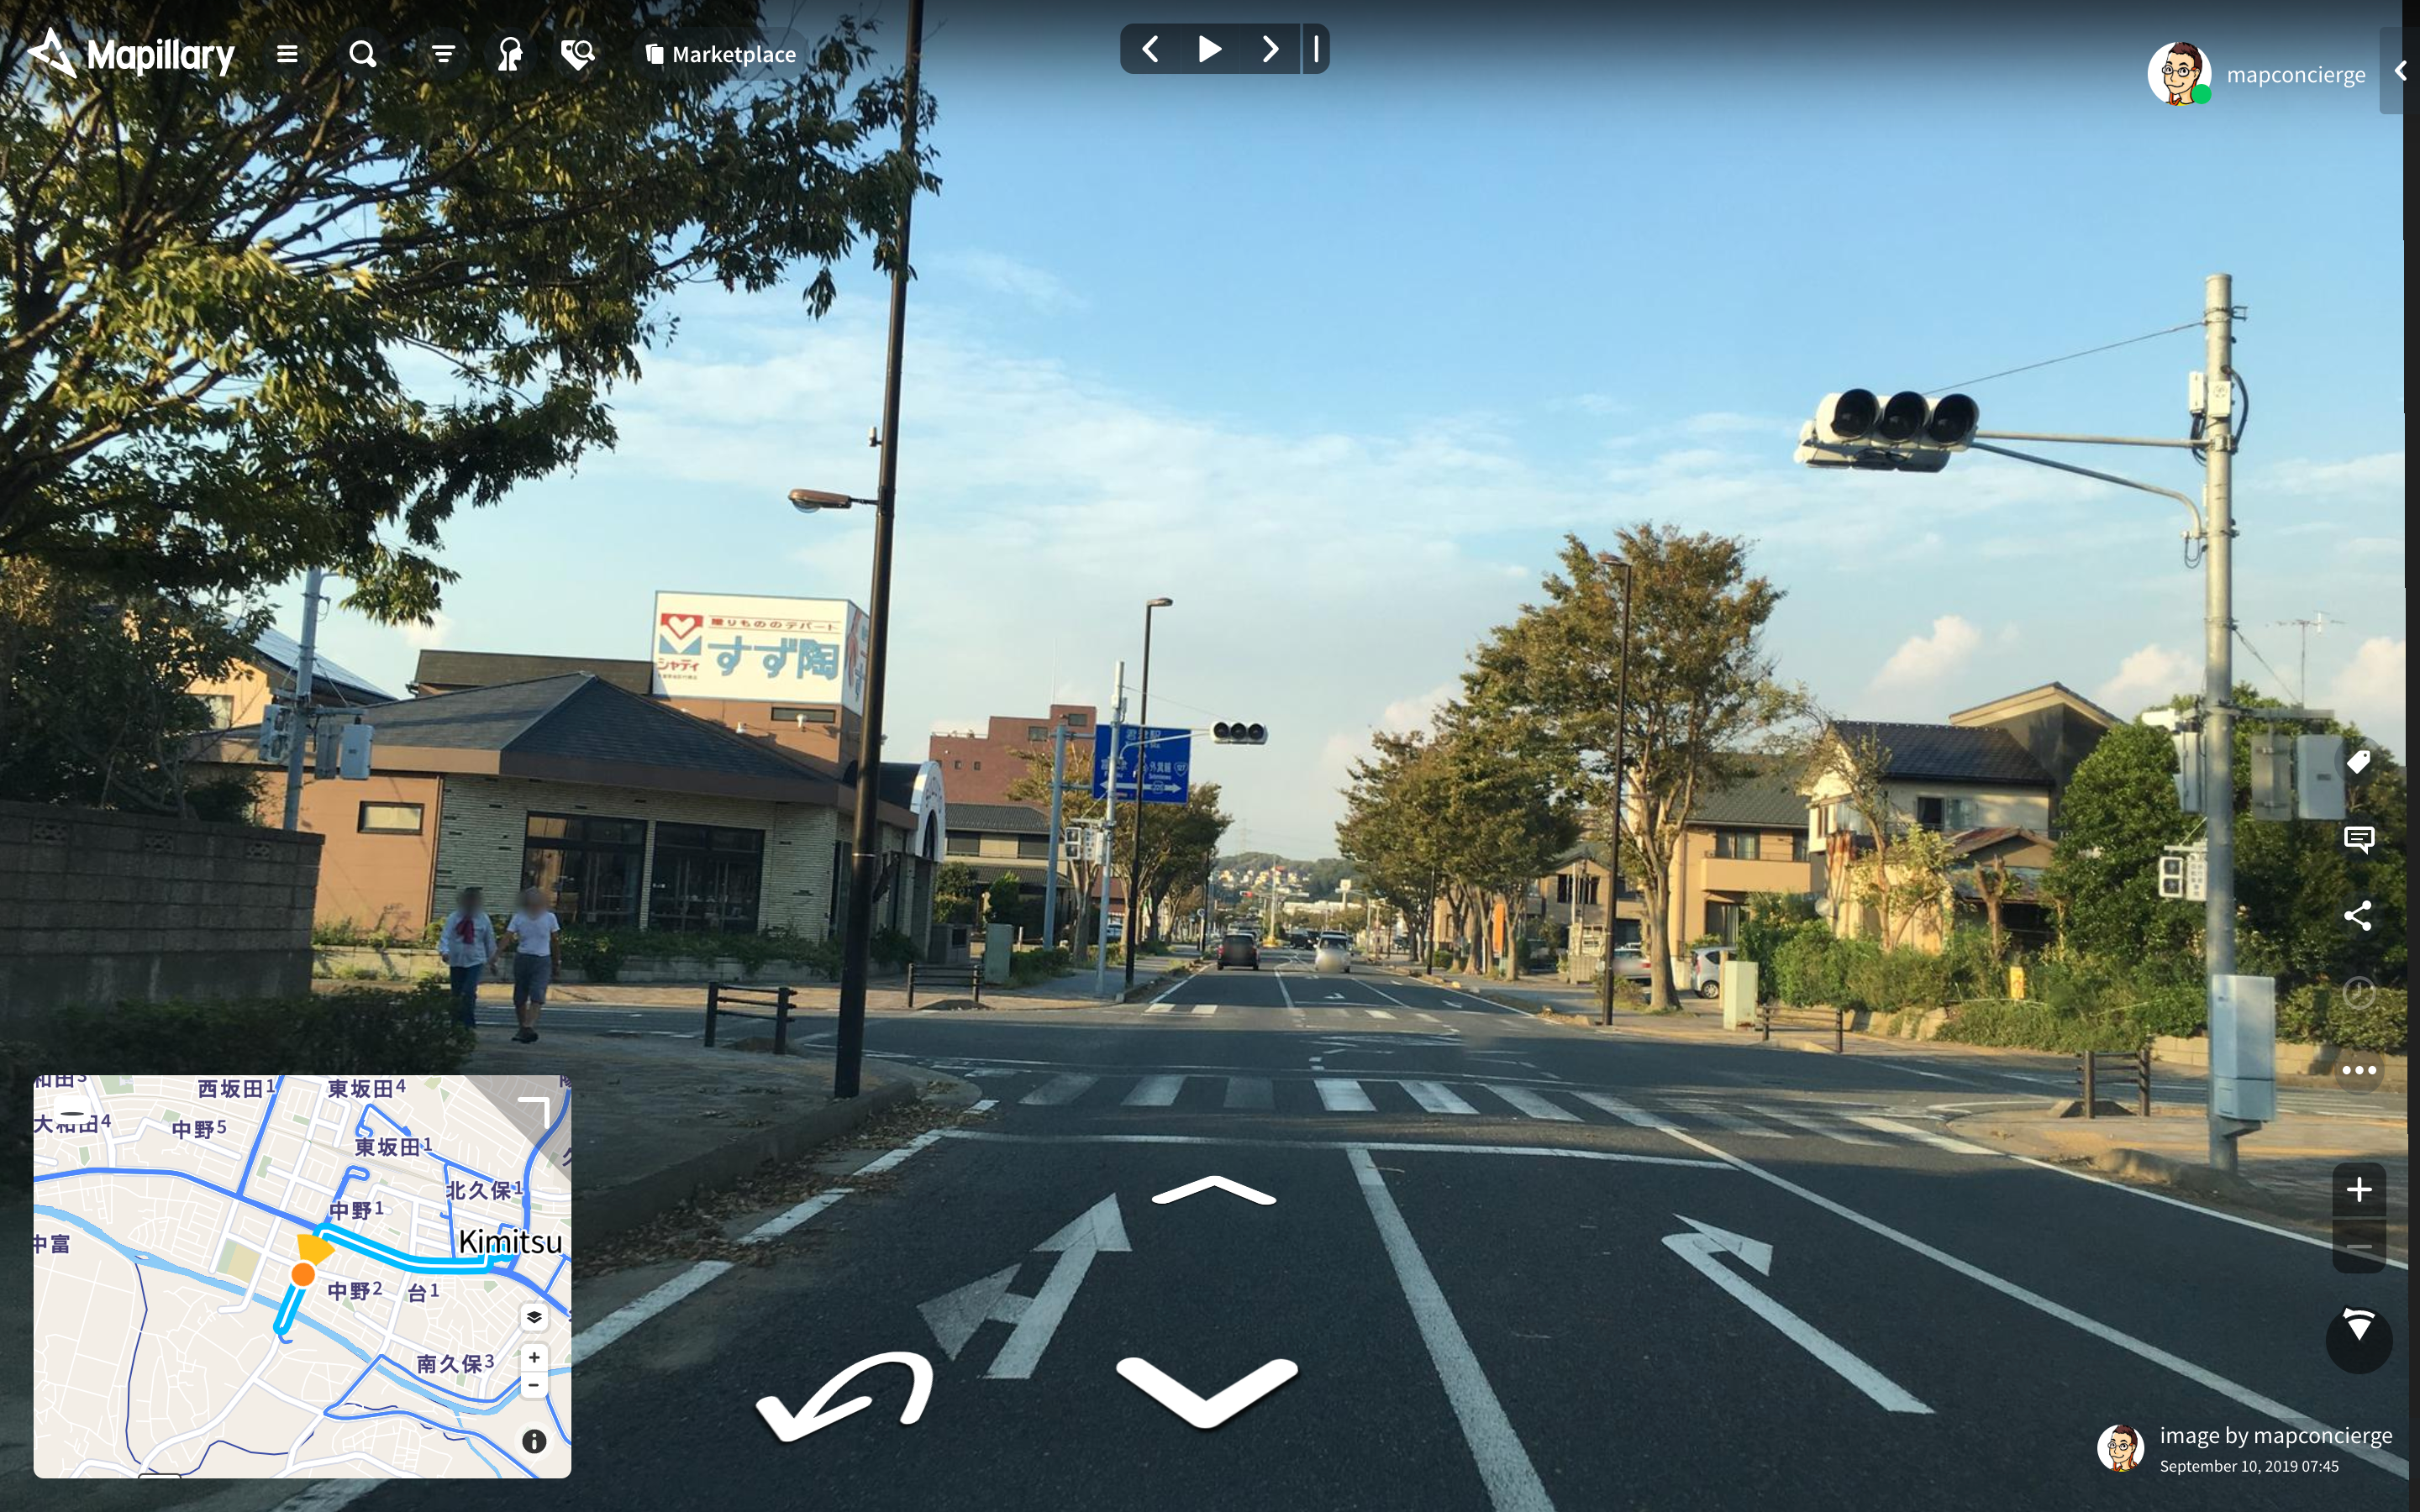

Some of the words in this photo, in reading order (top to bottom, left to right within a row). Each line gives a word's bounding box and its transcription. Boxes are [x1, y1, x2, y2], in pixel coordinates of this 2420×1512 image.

[656, 657, 700, 672] シャディ
[708, 635, 840, 680] すず陶
